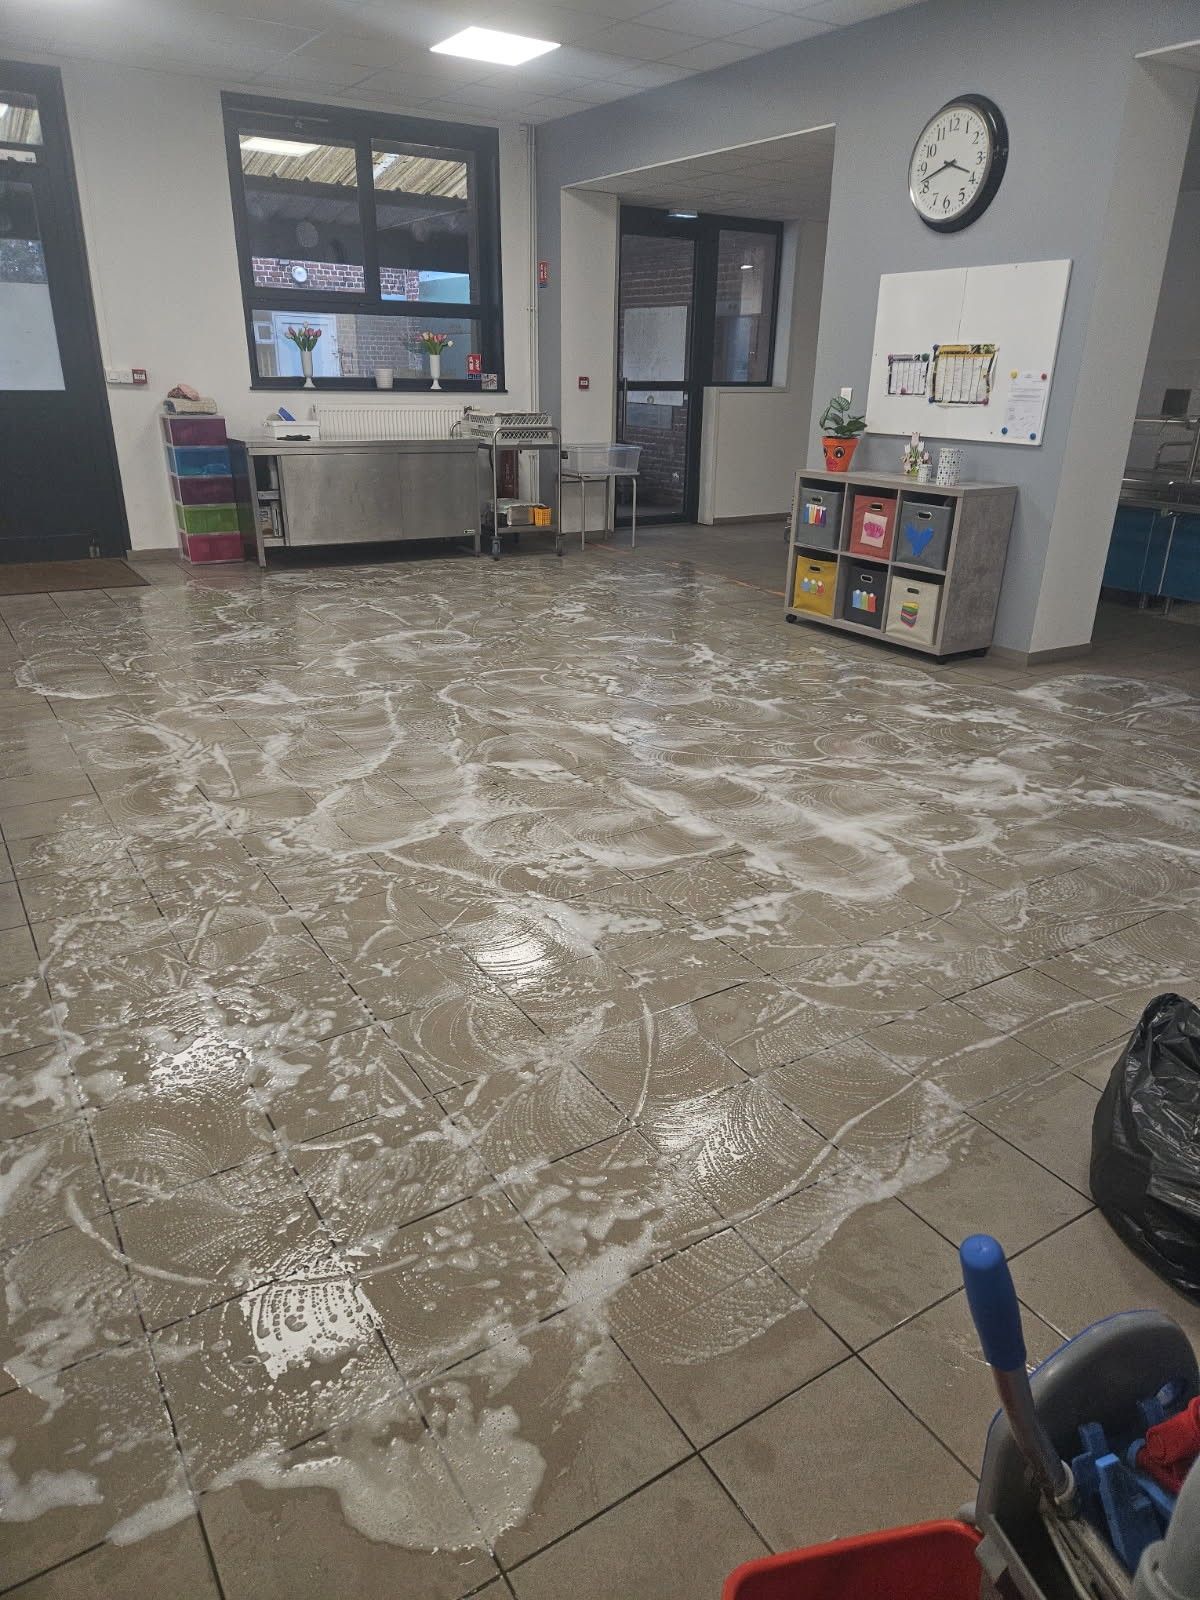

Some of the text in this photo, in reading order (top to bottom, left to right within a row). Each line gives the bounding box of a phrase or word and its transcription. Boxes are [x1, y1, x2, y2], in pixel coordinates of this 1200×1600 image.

[949, 117, 960, 131] 12
[965, 120, 970, 133] 1
[936, 127, 946, 141] 11
[972, 131, 979, 144] 2
[926, 144, 937, 158] 10
[976, 151, 983, 165] 3
[920, 162, 927, 176] 9
[969, 172, 977, 184] 4
[922, 181, 929, 193] 8
[932, 193, 939, 206] 7
[943, 195, 951, 209] 6
[958, 188, 966, 202] 5
